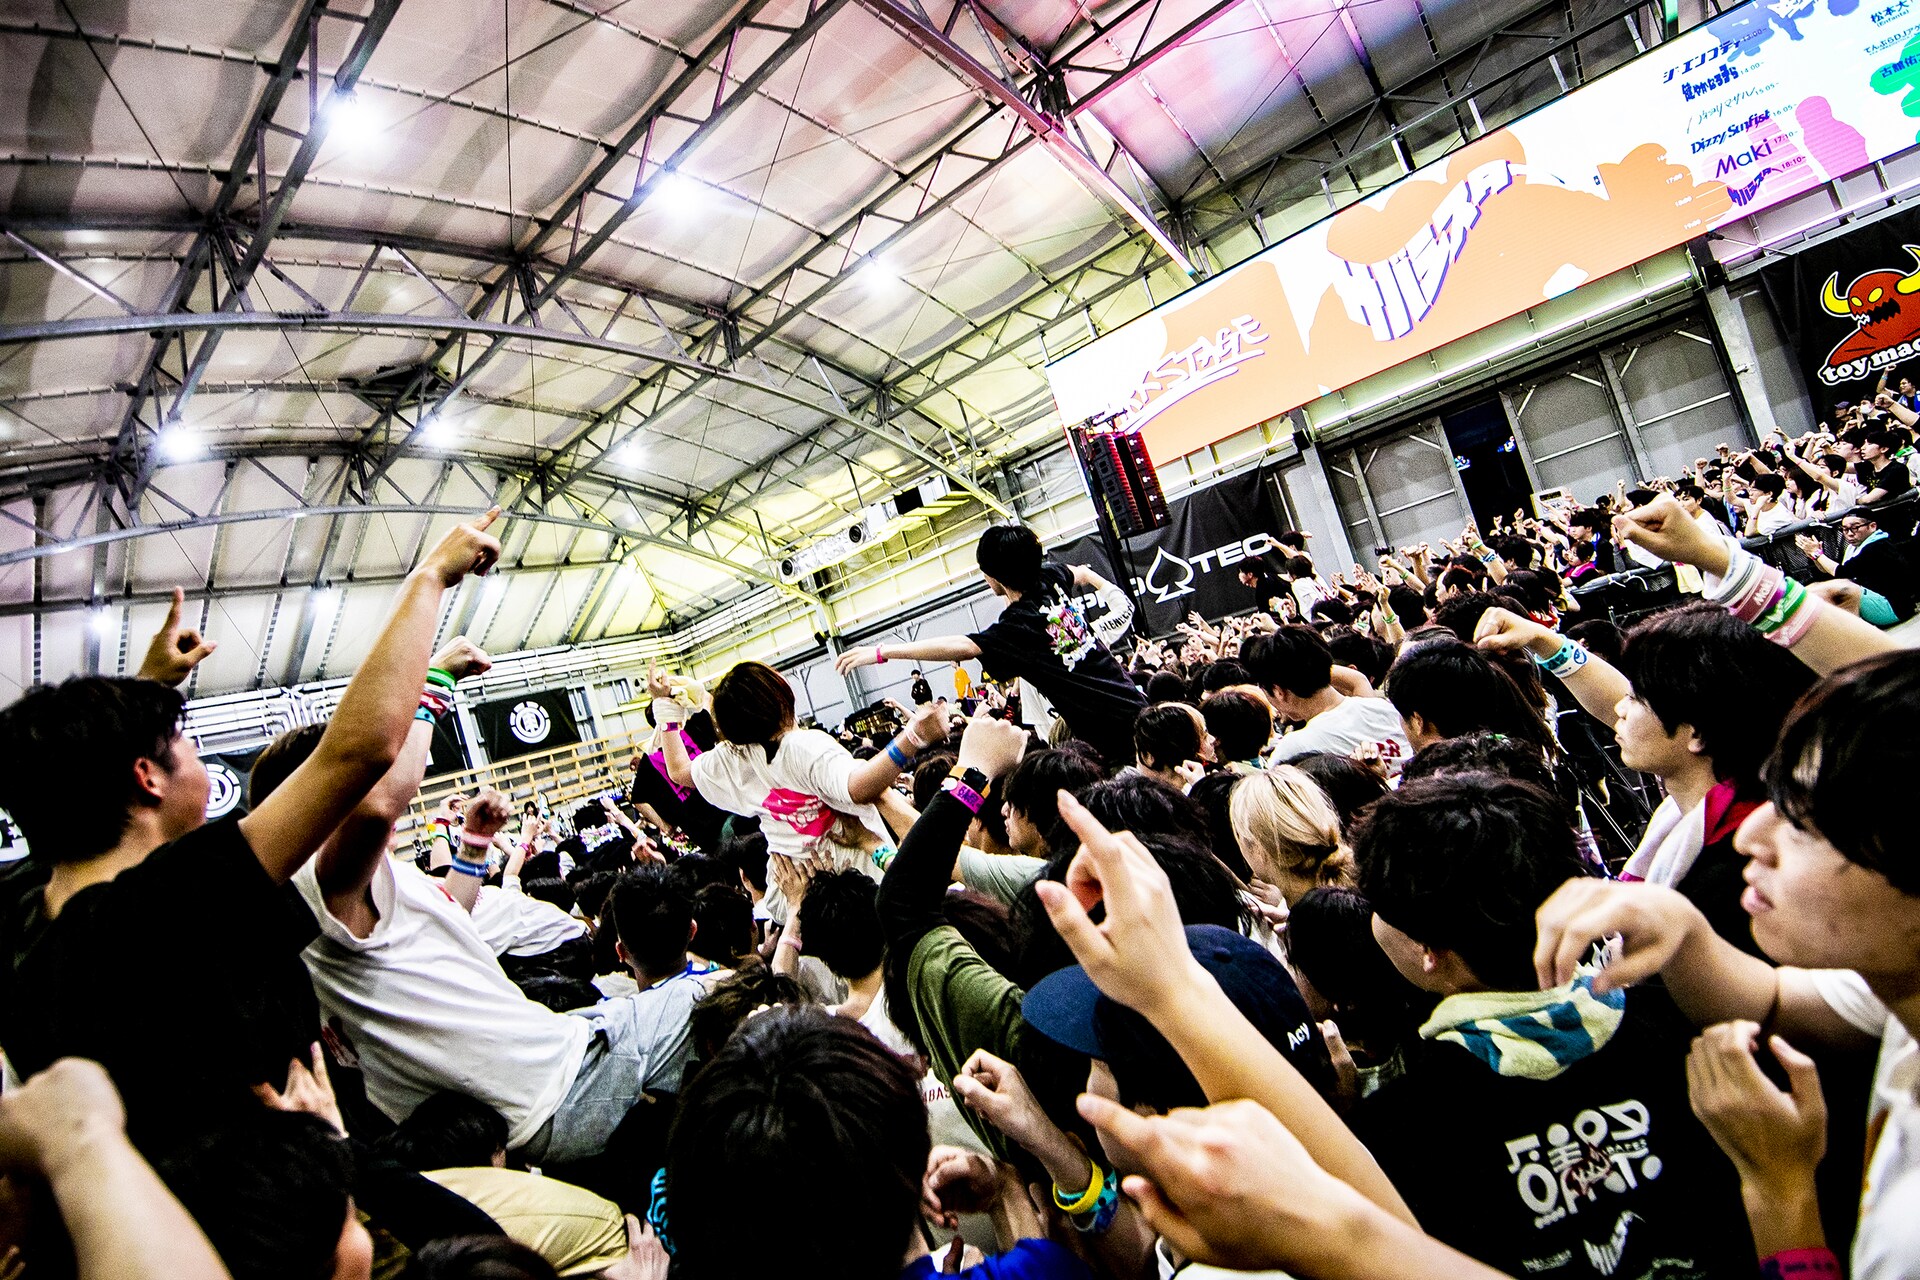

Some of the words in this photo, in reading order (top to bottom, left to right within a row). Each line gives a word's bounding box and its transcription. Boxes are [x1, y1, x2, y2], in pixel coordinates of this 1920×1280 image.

[1690, 131, 1727, 154] Dizzy
[1728, 109, 1771, 137] Sunfist
[1715, 138, 1773, 178] Maki
[1822, 356, 1869, 382] toy
